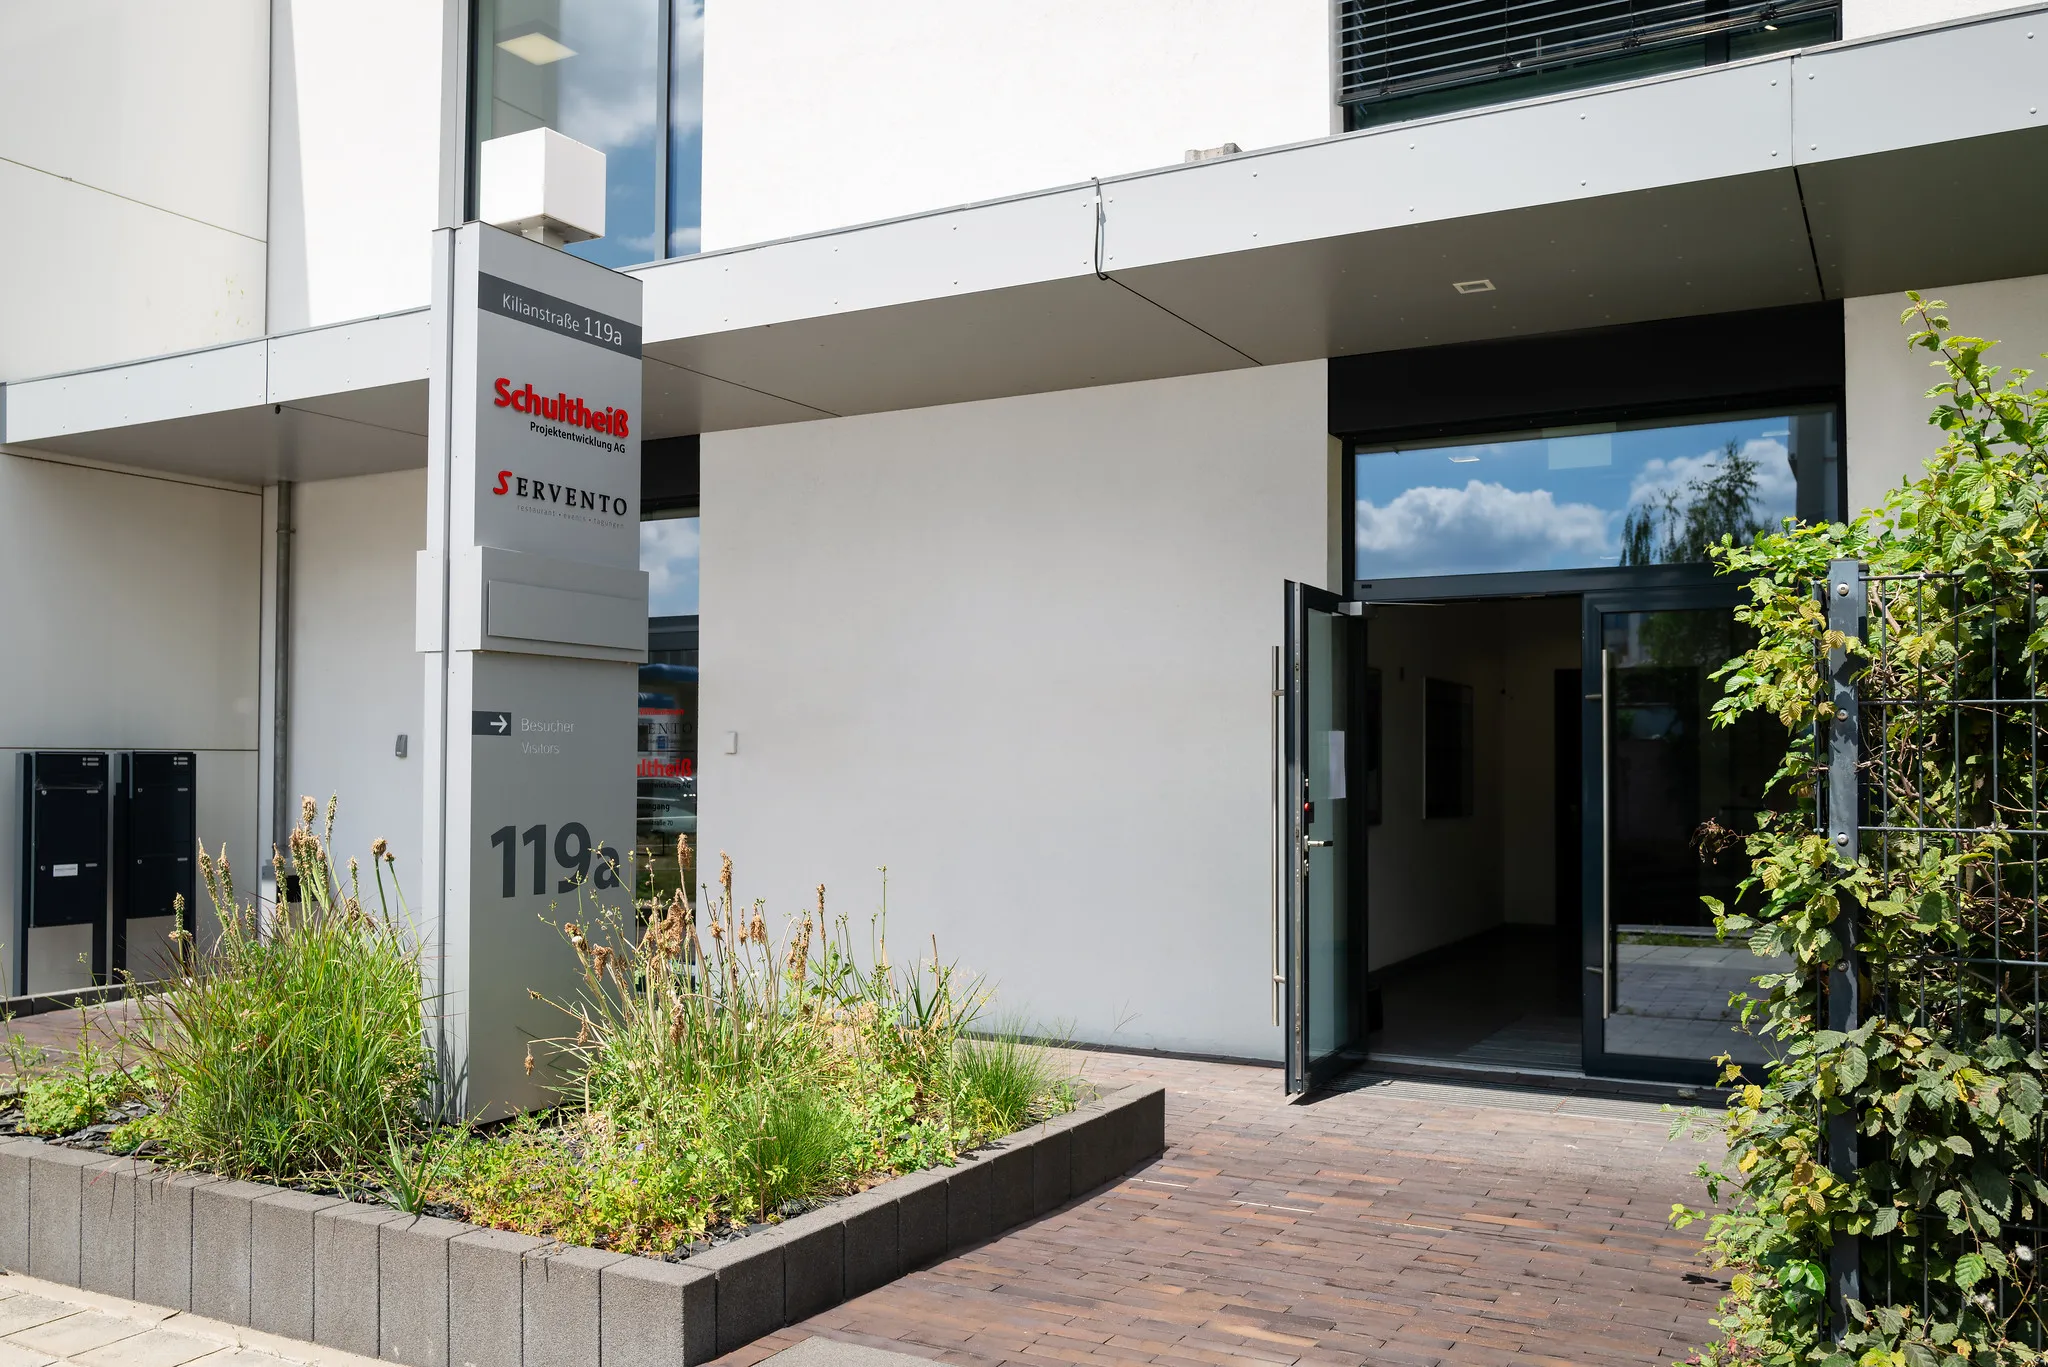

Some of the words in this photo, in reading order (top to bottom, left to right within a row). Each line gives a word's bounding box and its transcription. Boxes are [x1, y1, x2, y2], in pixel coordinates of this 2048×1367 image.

[502, 292, 580, 332] Kilianstraße
[584, 316, 623, 346] 119a
[493, 377, 630, 439] Schultheiß
[530, 421, 612, 453] Projektentwicklung
[613, 442, 626, 454] AG
[492, 470, 628, 516] SERVENTO
[521, 718, 575, 733] Besucher
[646, 722, 693, 735] ENTO
[521, 741, 560, 754] Visitors
[490, 821, 620, 898] 119a
